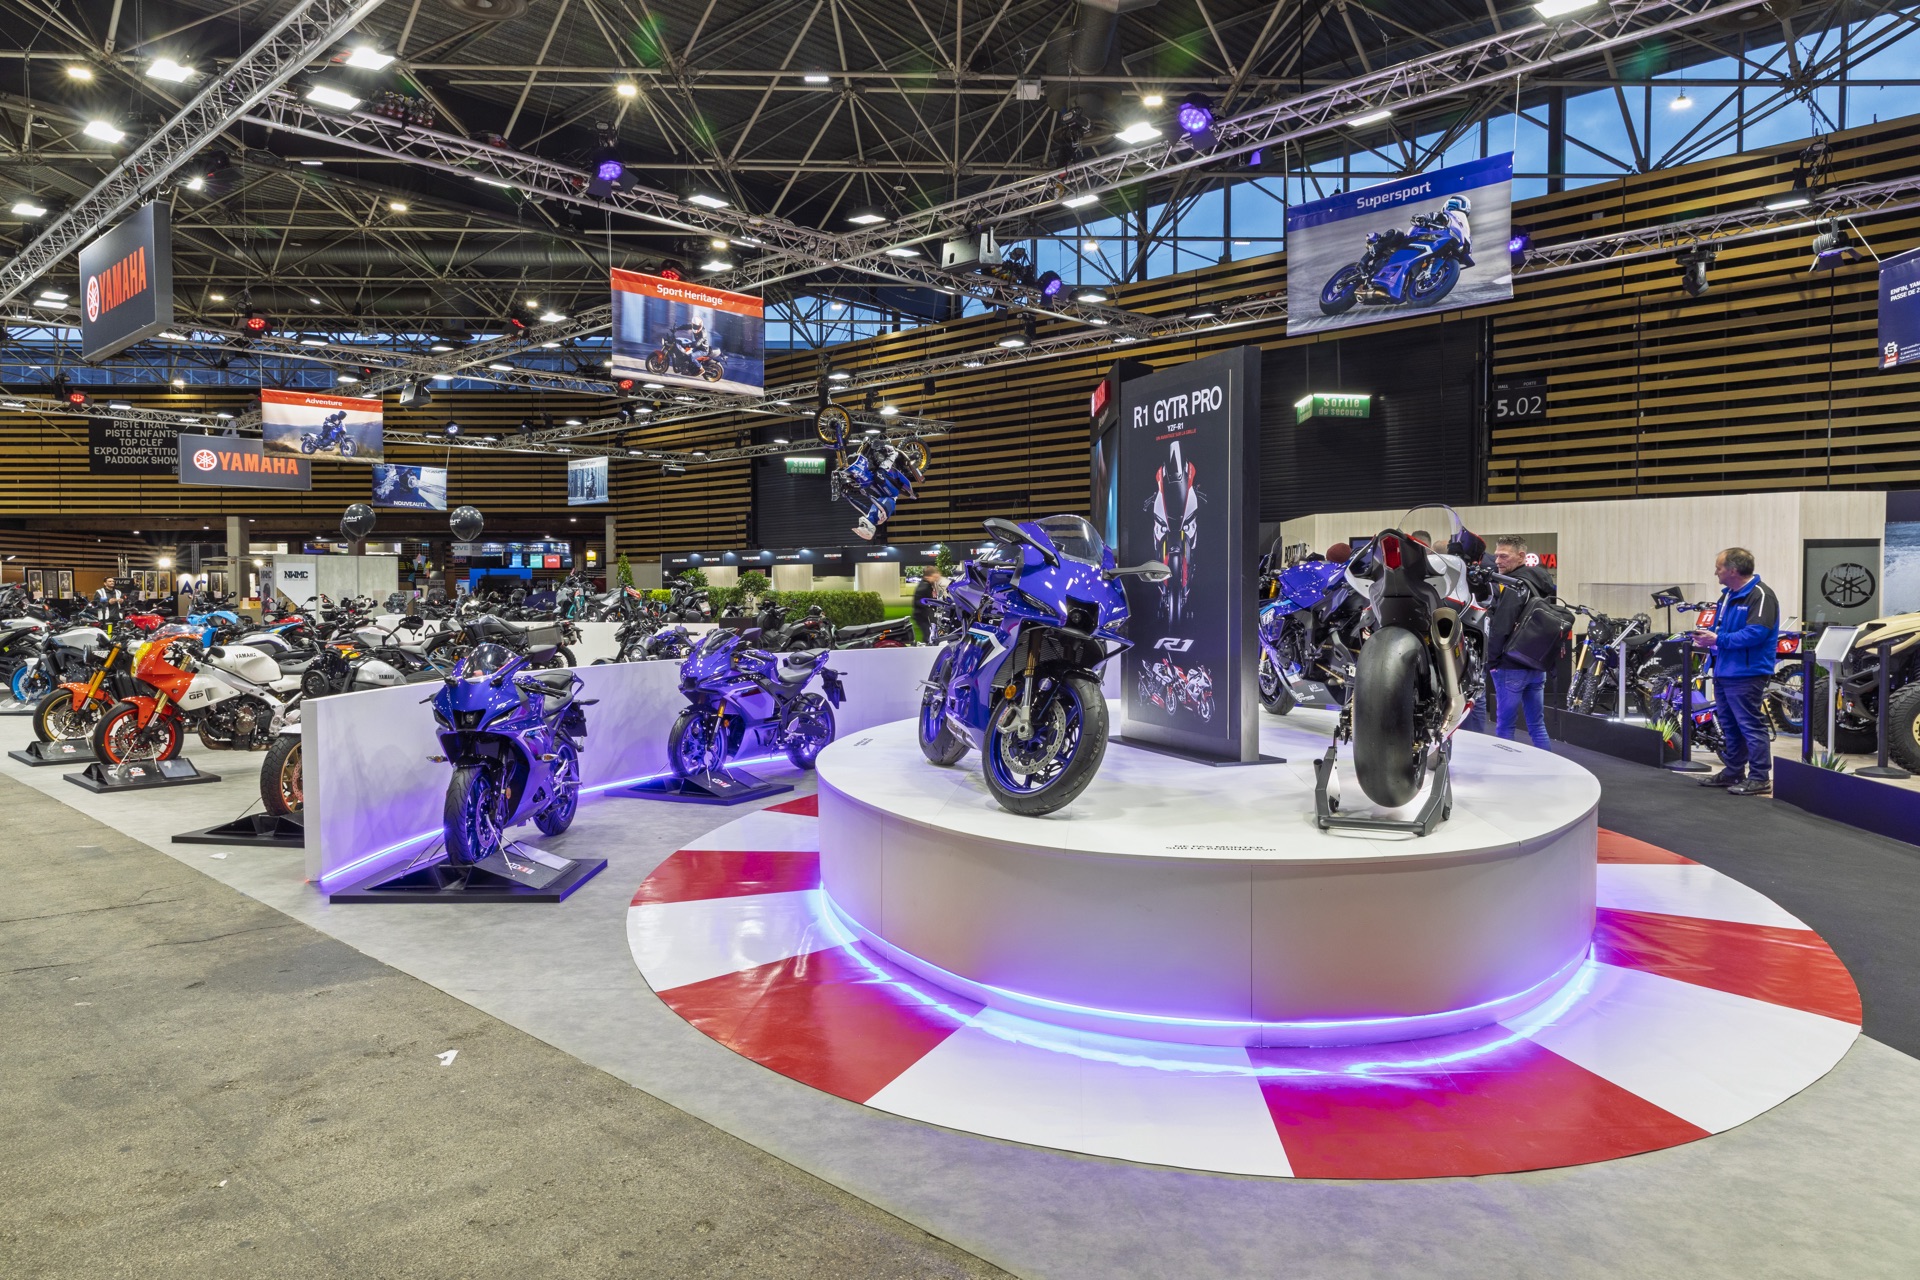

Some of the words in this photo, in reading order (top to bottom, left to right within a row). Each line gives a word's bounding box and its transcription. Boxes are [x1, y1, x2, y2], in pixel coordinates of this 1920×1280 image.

[1356, 181, 1432, 209] Supersport
[98, 246, 147, 315] YAMAHA
[656, 284, 683, 297] Sport
[684, 290, 723, 306] Heritage
[1890, 291, 1907, 301] PASSE
[305, 398, 343, 407] Adventure
[1133, 404, 1149, 429] R1
[1153, 394, 1188, 423] GYTR
[1191, 385, 1223, 415] PRO
[1323, 397, 1360, 407] Sortie
[1497, 396, 1542, 418] 5.02
[1319, 407, 1329, 415] de
[114, 420, 140, 429] PISTE
[144, 421, 169, 429] TRAIL
[1167, 422, 1184, 432] YZF-R1
[106, 430, 132, 438] PISTE
[134, 430, 178, 438] ENFANTS
[120, 439, 138, 447] TOP
[140, 439, 164, 447] CLEF
[94, 447, 119, 455] EXPO
[105, 456, 149, 465] PADDOCK
[218, 451, 299, 475] YAMAHA
[284, 571, 309, 579] NWMC
[1154, 637, 1195, 653] R1
